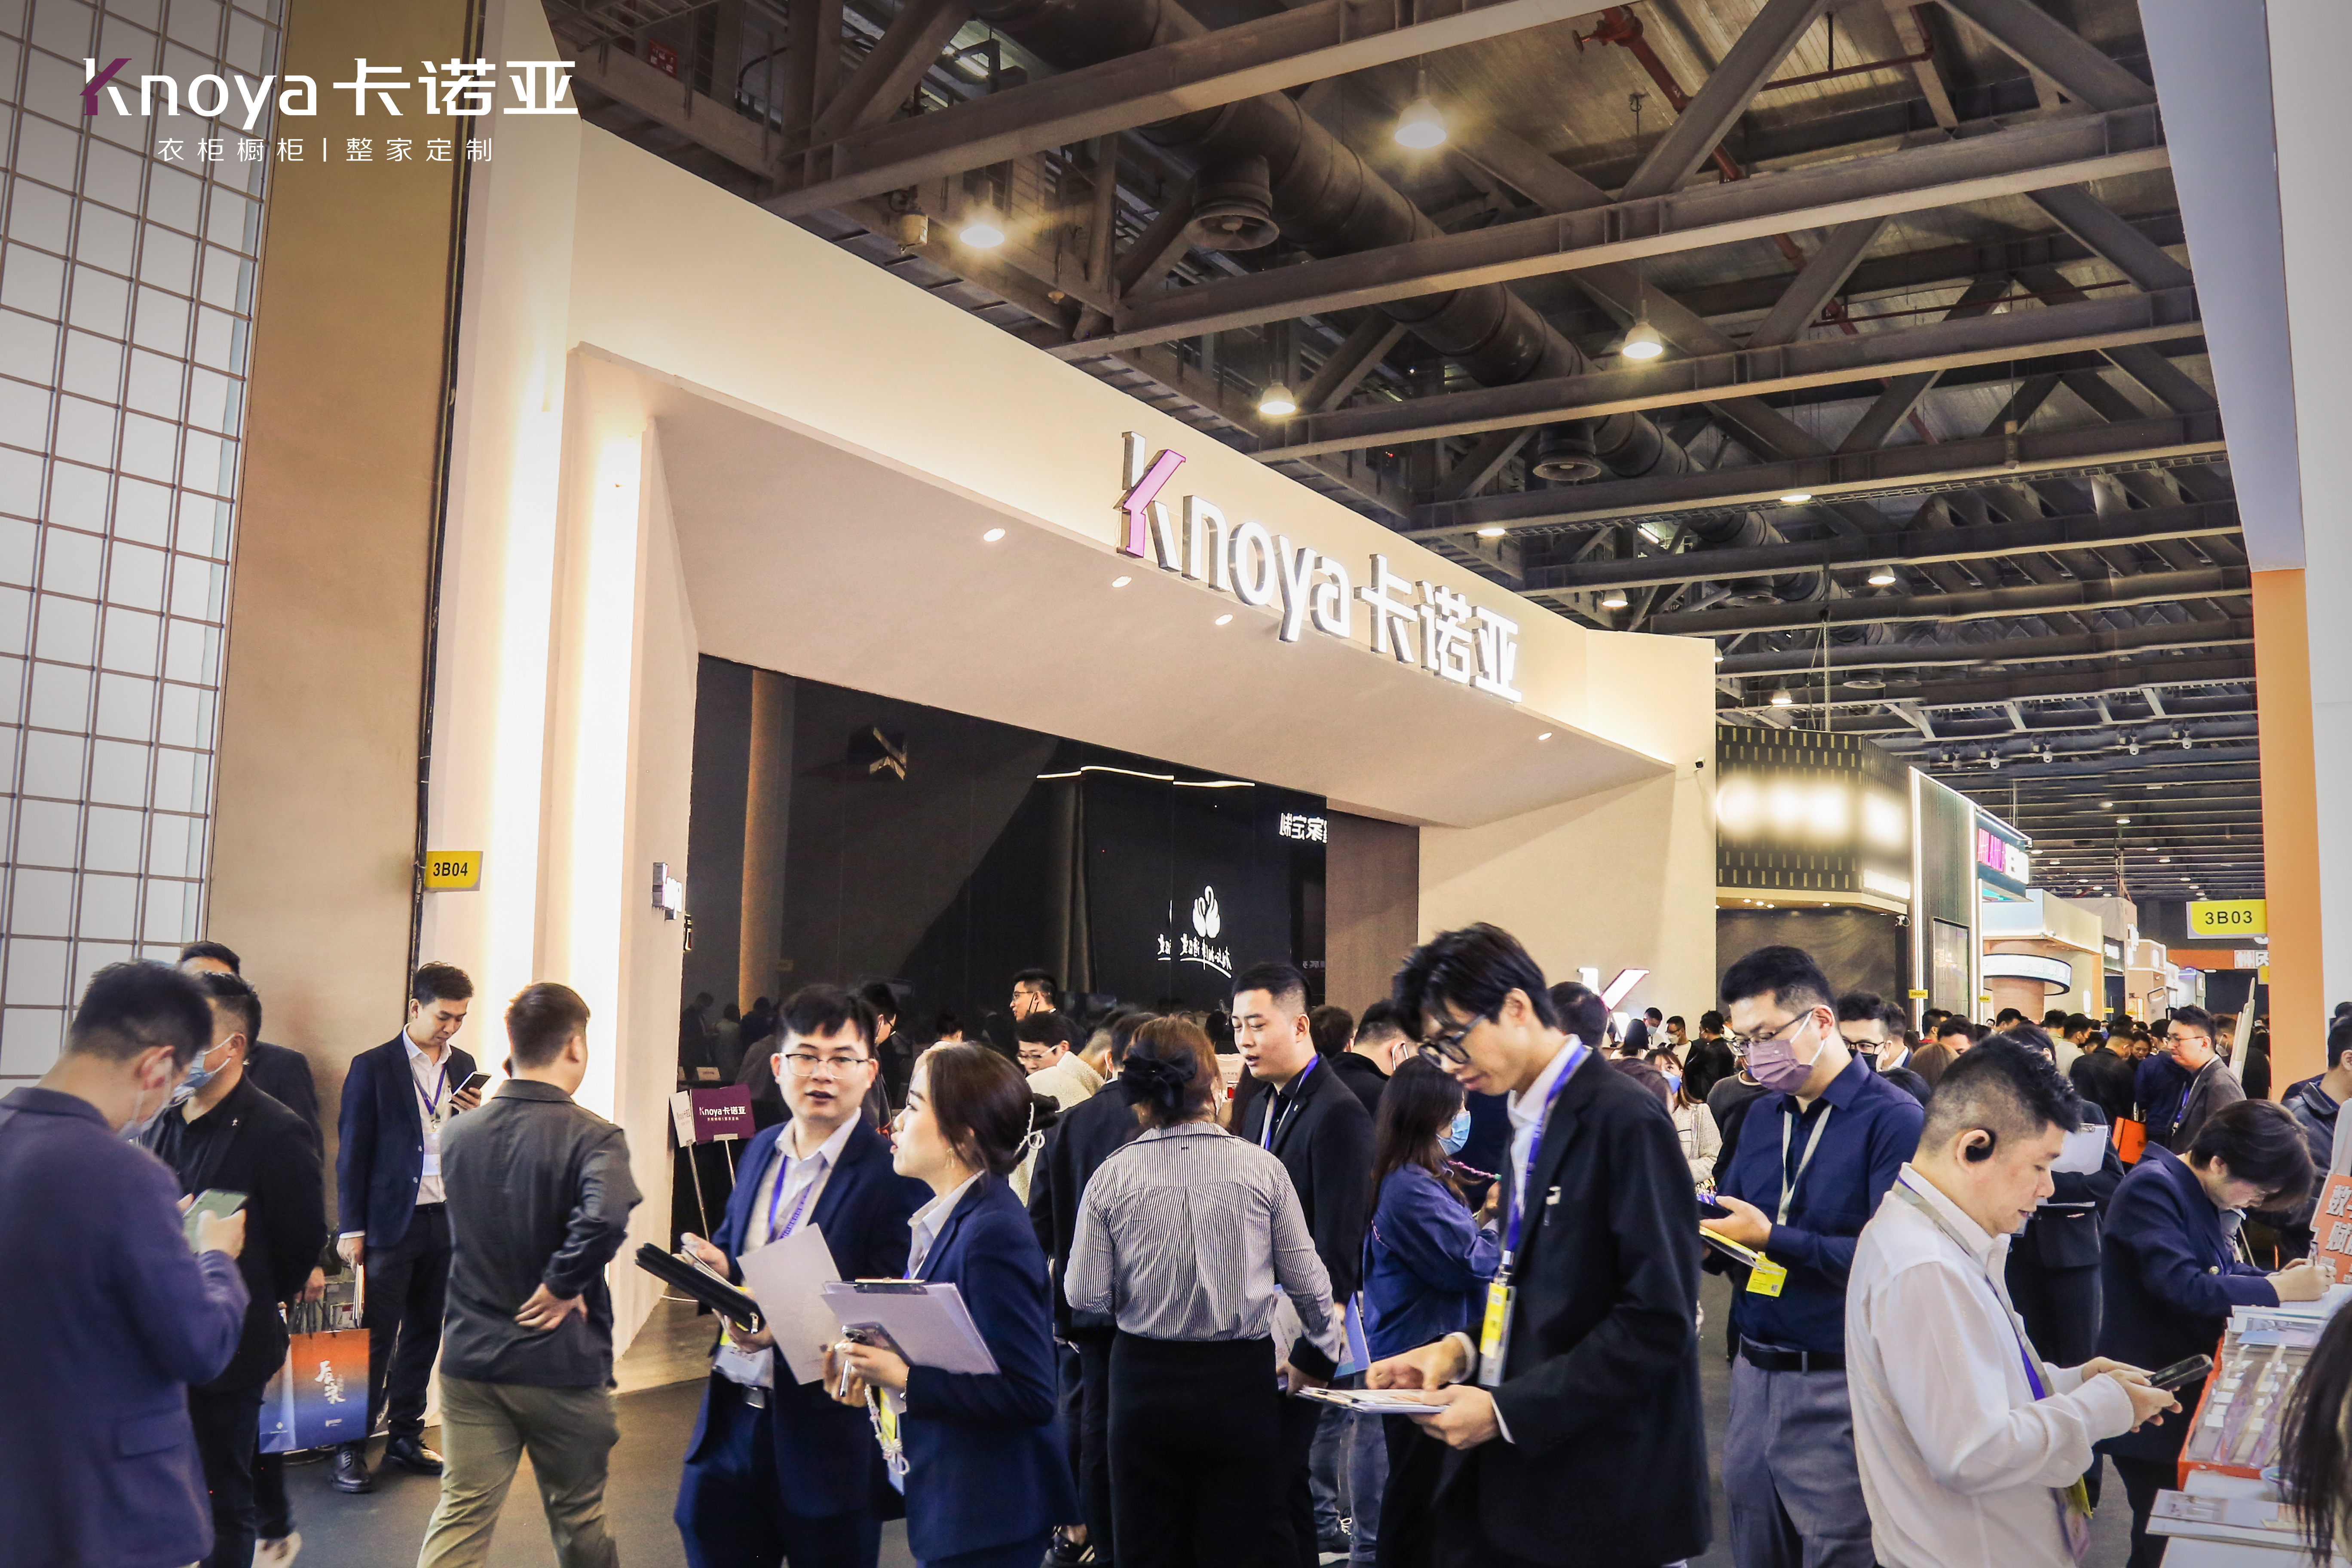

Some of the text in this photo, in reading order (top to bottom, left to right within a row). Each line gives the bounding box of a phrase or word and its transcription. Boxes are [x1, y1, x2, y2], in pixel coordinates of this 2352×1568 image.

[1113, 431, 1522, 702] Knoya 卡诺亚
[433, 862, 468, 876] 3B04
[2205, 911, 2252, 924] 3B03
[699, 1107, 722, 1117] Knoya
[723, 1106, 746, 1115] 卡诺亚
